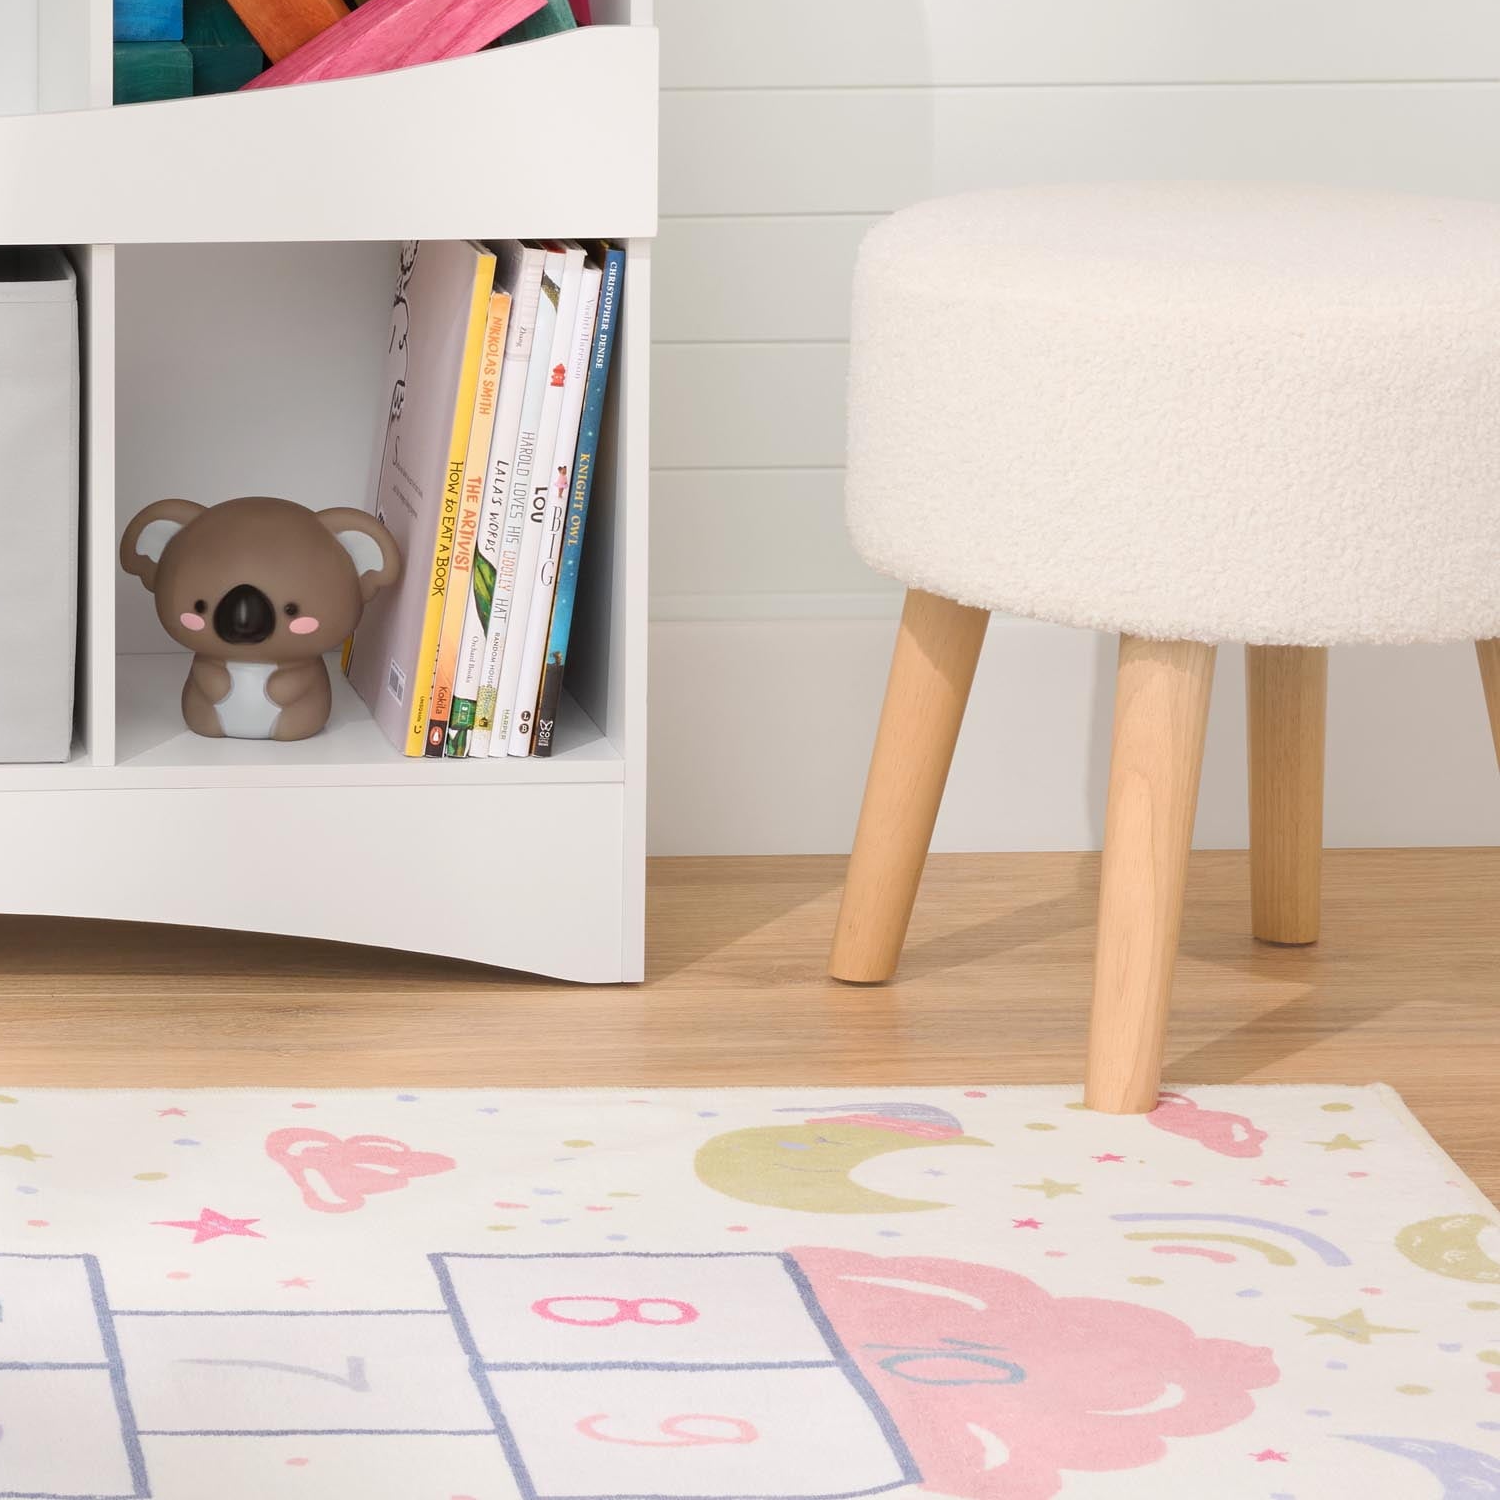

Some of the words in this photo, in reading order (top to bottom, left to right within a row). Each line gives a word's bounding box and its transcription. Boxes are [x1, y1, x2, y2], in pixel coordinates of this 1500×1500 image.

[601, 261, 618, 330] CHRISTOPHER
[483, 316, 503, 375] NIKKOLAS
[596, 335, 608, 369] DENISE
[479, 380, 495, 415] SMITH
[516, 431, 535, 476] HAROLD
[466, 476, 482, 503] THE
[491, 460, 510, 506] LALA'S
[573, 453, 591, 511] KNIGHT
[444, 499, 458, 513] to
[509, 483, 528, 519] LOVES
[530, 487, 548, 524] LOU
[441, 516, 455, 542] EAT
[453, 508, 477, 572] ARTIVIST
[485, 512, 500, 553] WORDS
[505, 525, 521, 544] HIS
[541, 505, 562, 586] BIG
[567, 515, 581, 546] OWL
[439, 543, 450, 553] A
[431, 556, 450, 597] BOOK
[498, 550, 517, 592] WOOLLY
[493, 598, 509, 624] HAT
[491, 632, 501, 663] RANDOM
[486, 664, 496, 689] HOUSE
[435, 686, 448, 715] Kokila
[500, 709, 511, 740] HARPER
[531, 1296, 699, 1328] 8
[176, 1355, 371, 1394] 7
[575, 1411, 760, 1449] 9
